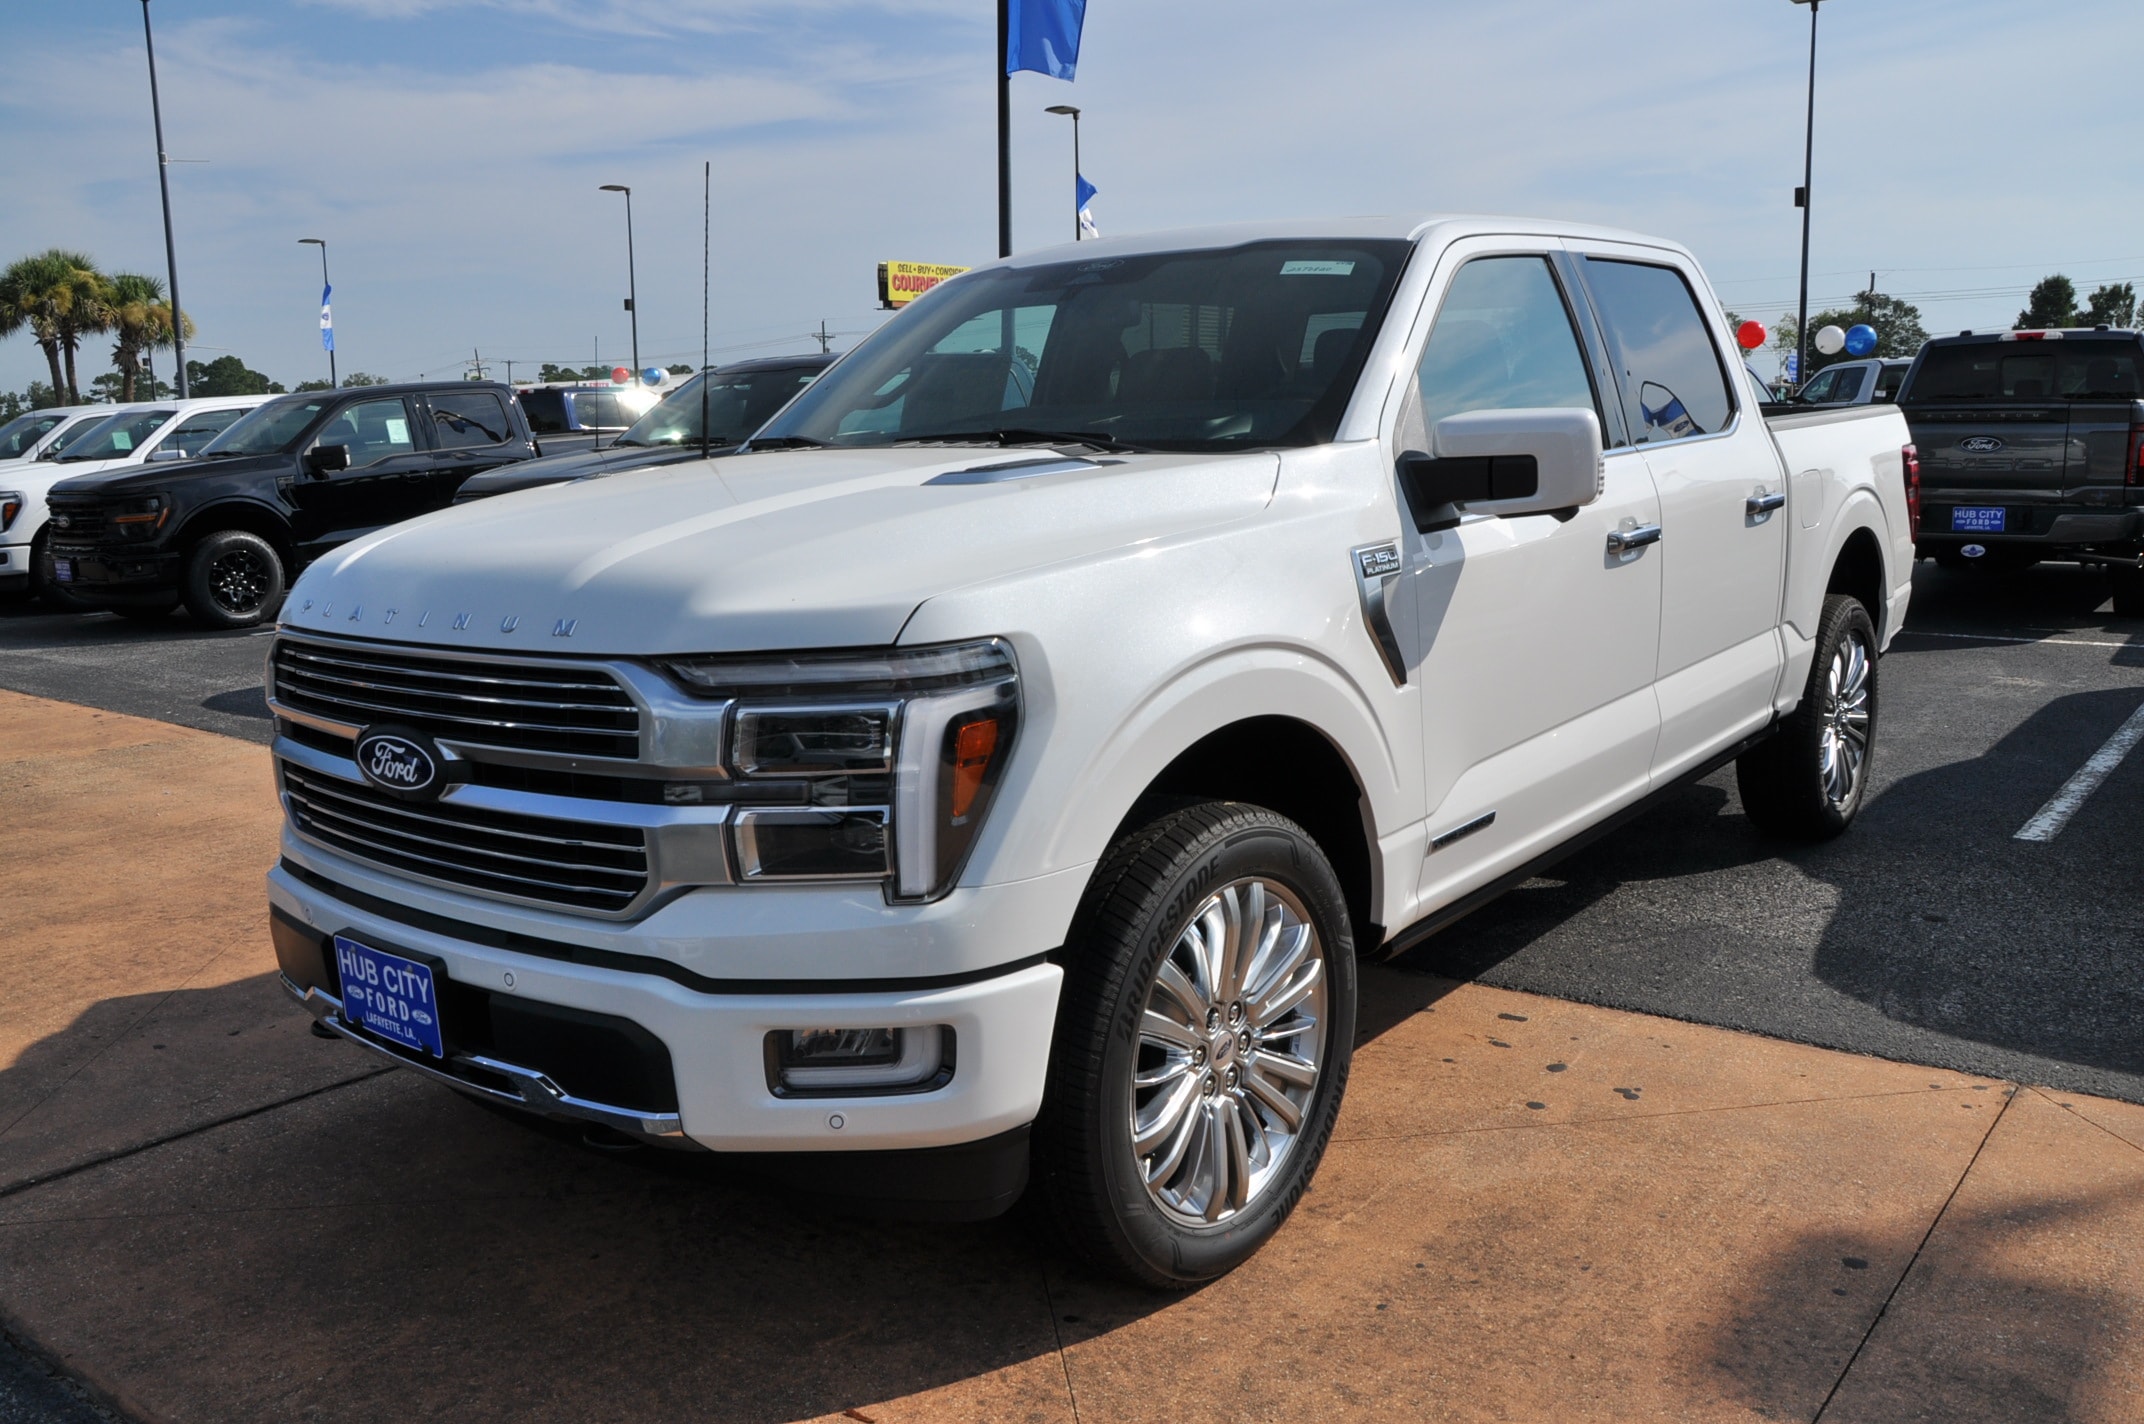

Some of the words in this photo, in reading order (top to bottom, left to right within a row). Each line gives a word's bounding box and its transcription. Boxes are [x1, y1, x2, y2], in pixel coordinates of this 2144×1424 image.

[897, 263, 912, 273] SELL
[917, 265, 931, 275] BUY
[892, 273, 945, 292] COURVE
[1967, 438, 1995, 450] Ford
[1954, 510, 1977, 518] HUB
[1979, 510, 2003, 519] CITY
[1362, 551, 1397, 566] F-150
[1367, 562, 1398, 575] PLATINUM
[302, 599, 579, 638] PLATINUM
[371, 741, 418, 783] Ford
[1117, 855, 1220, 1044] BRIDGESTONE
[338, 948, 379, 986] HUB
[382, 965, 429, 1004] CITY
[365, 987, 410, 1021] FORD
